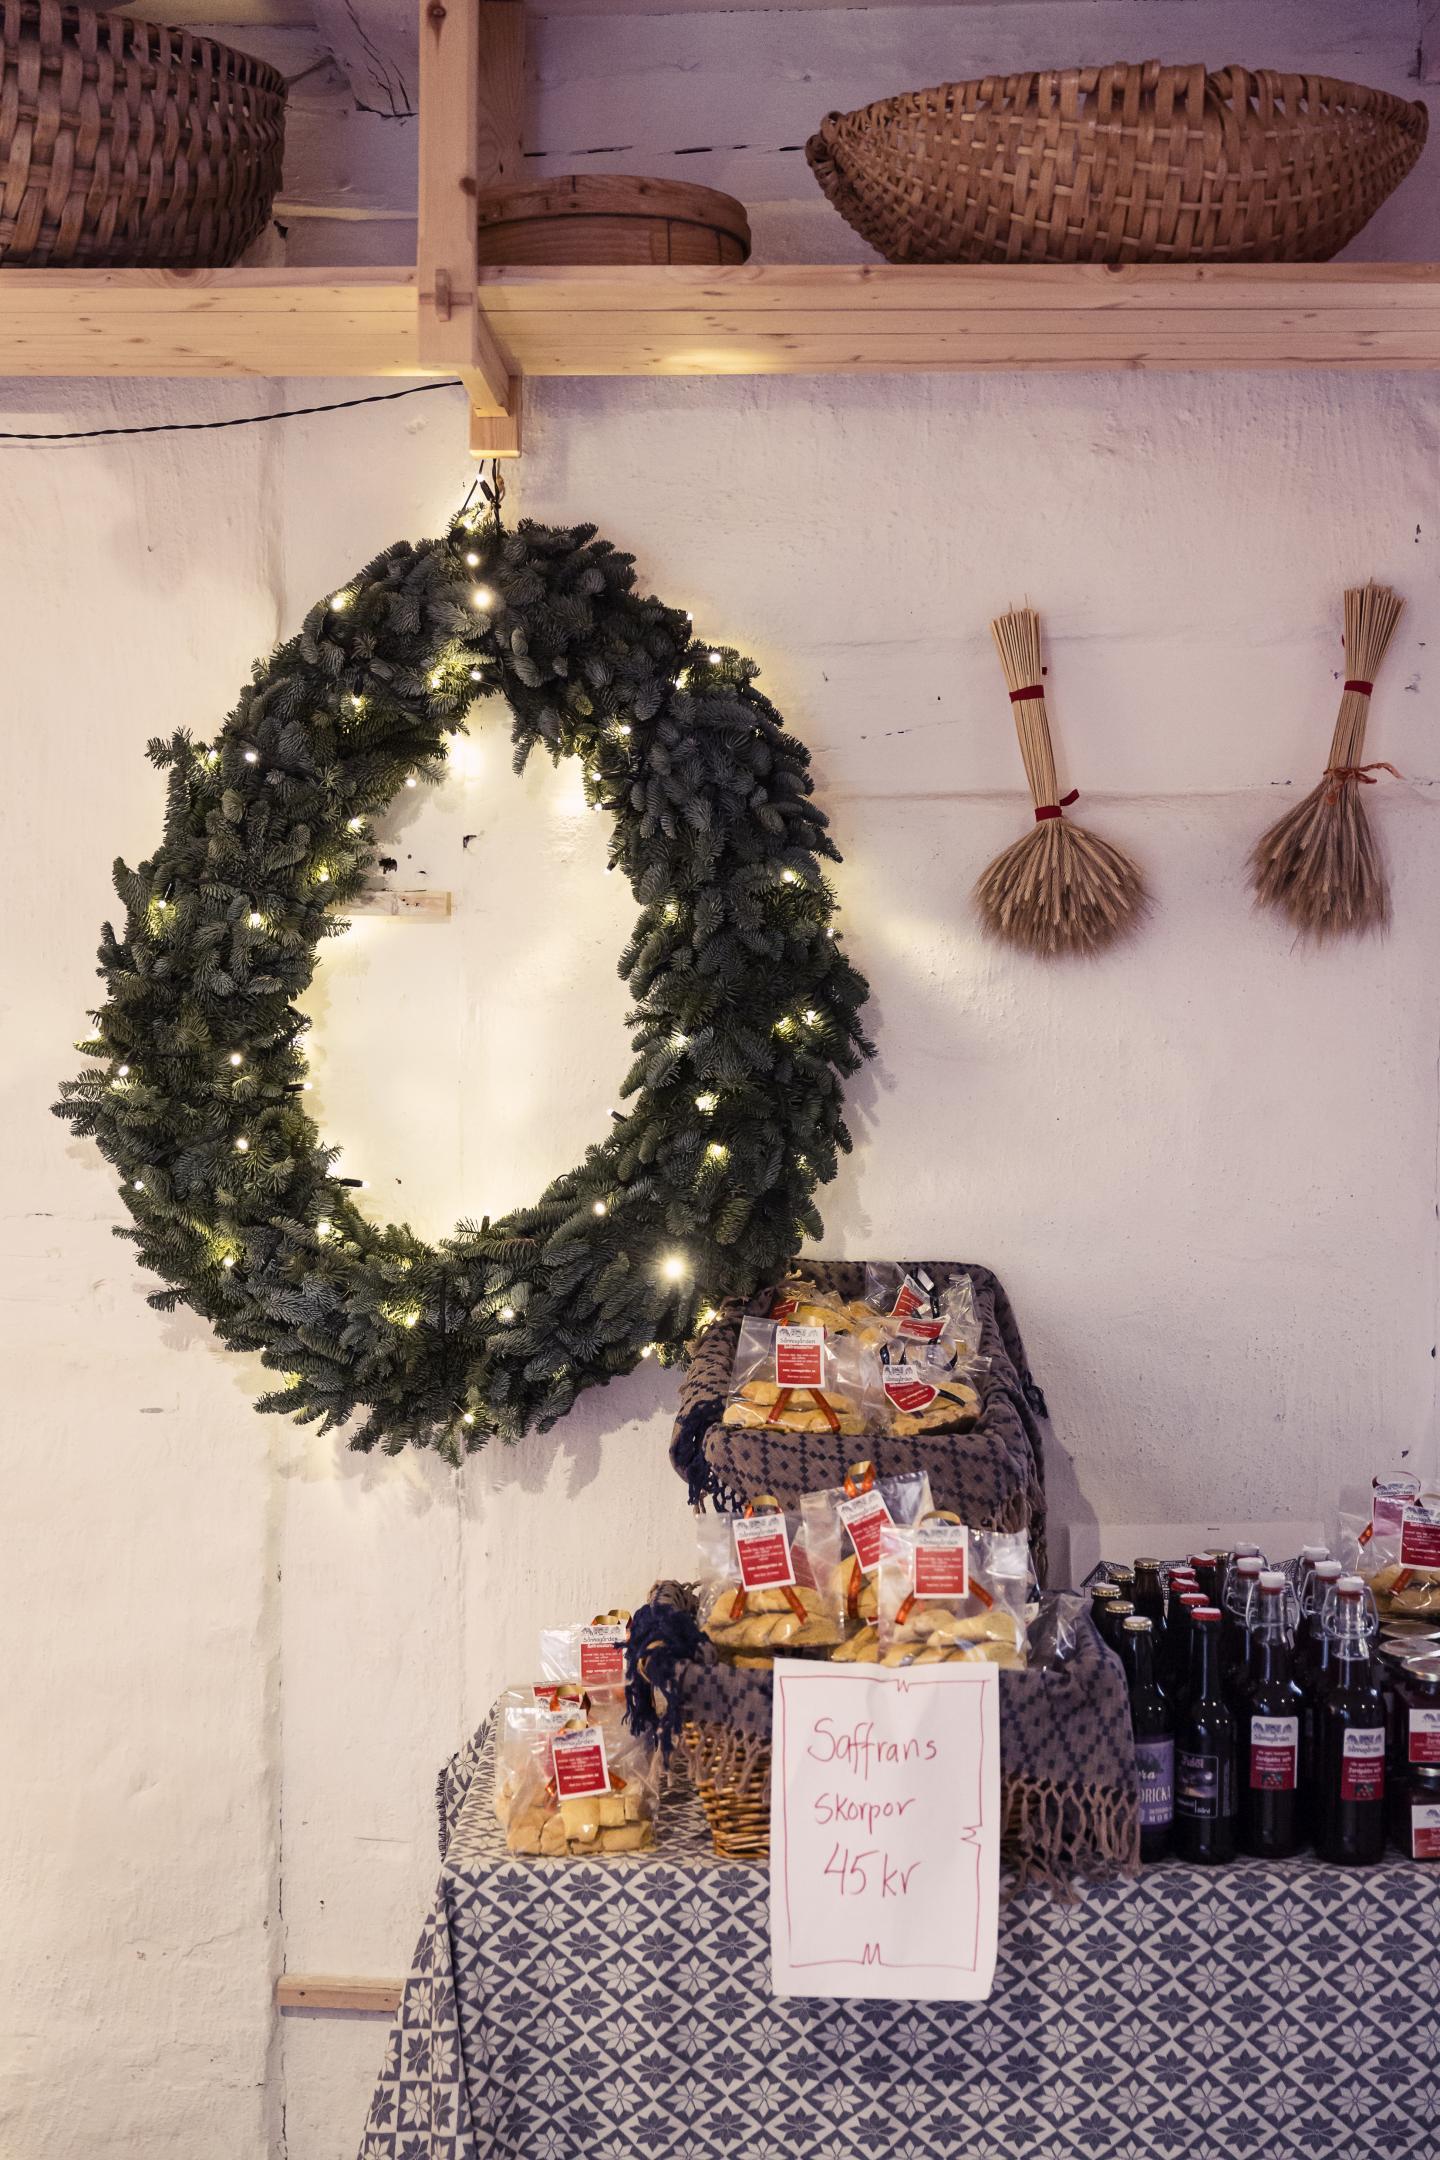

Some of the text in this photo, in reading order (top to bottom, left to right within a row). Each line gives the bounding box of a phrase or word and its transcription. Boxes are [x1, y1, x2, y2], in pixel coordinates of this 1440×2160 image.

[807, 1717, 937, 1781] Saffrans
[824, 1842, 921, 1898] 45 kr
